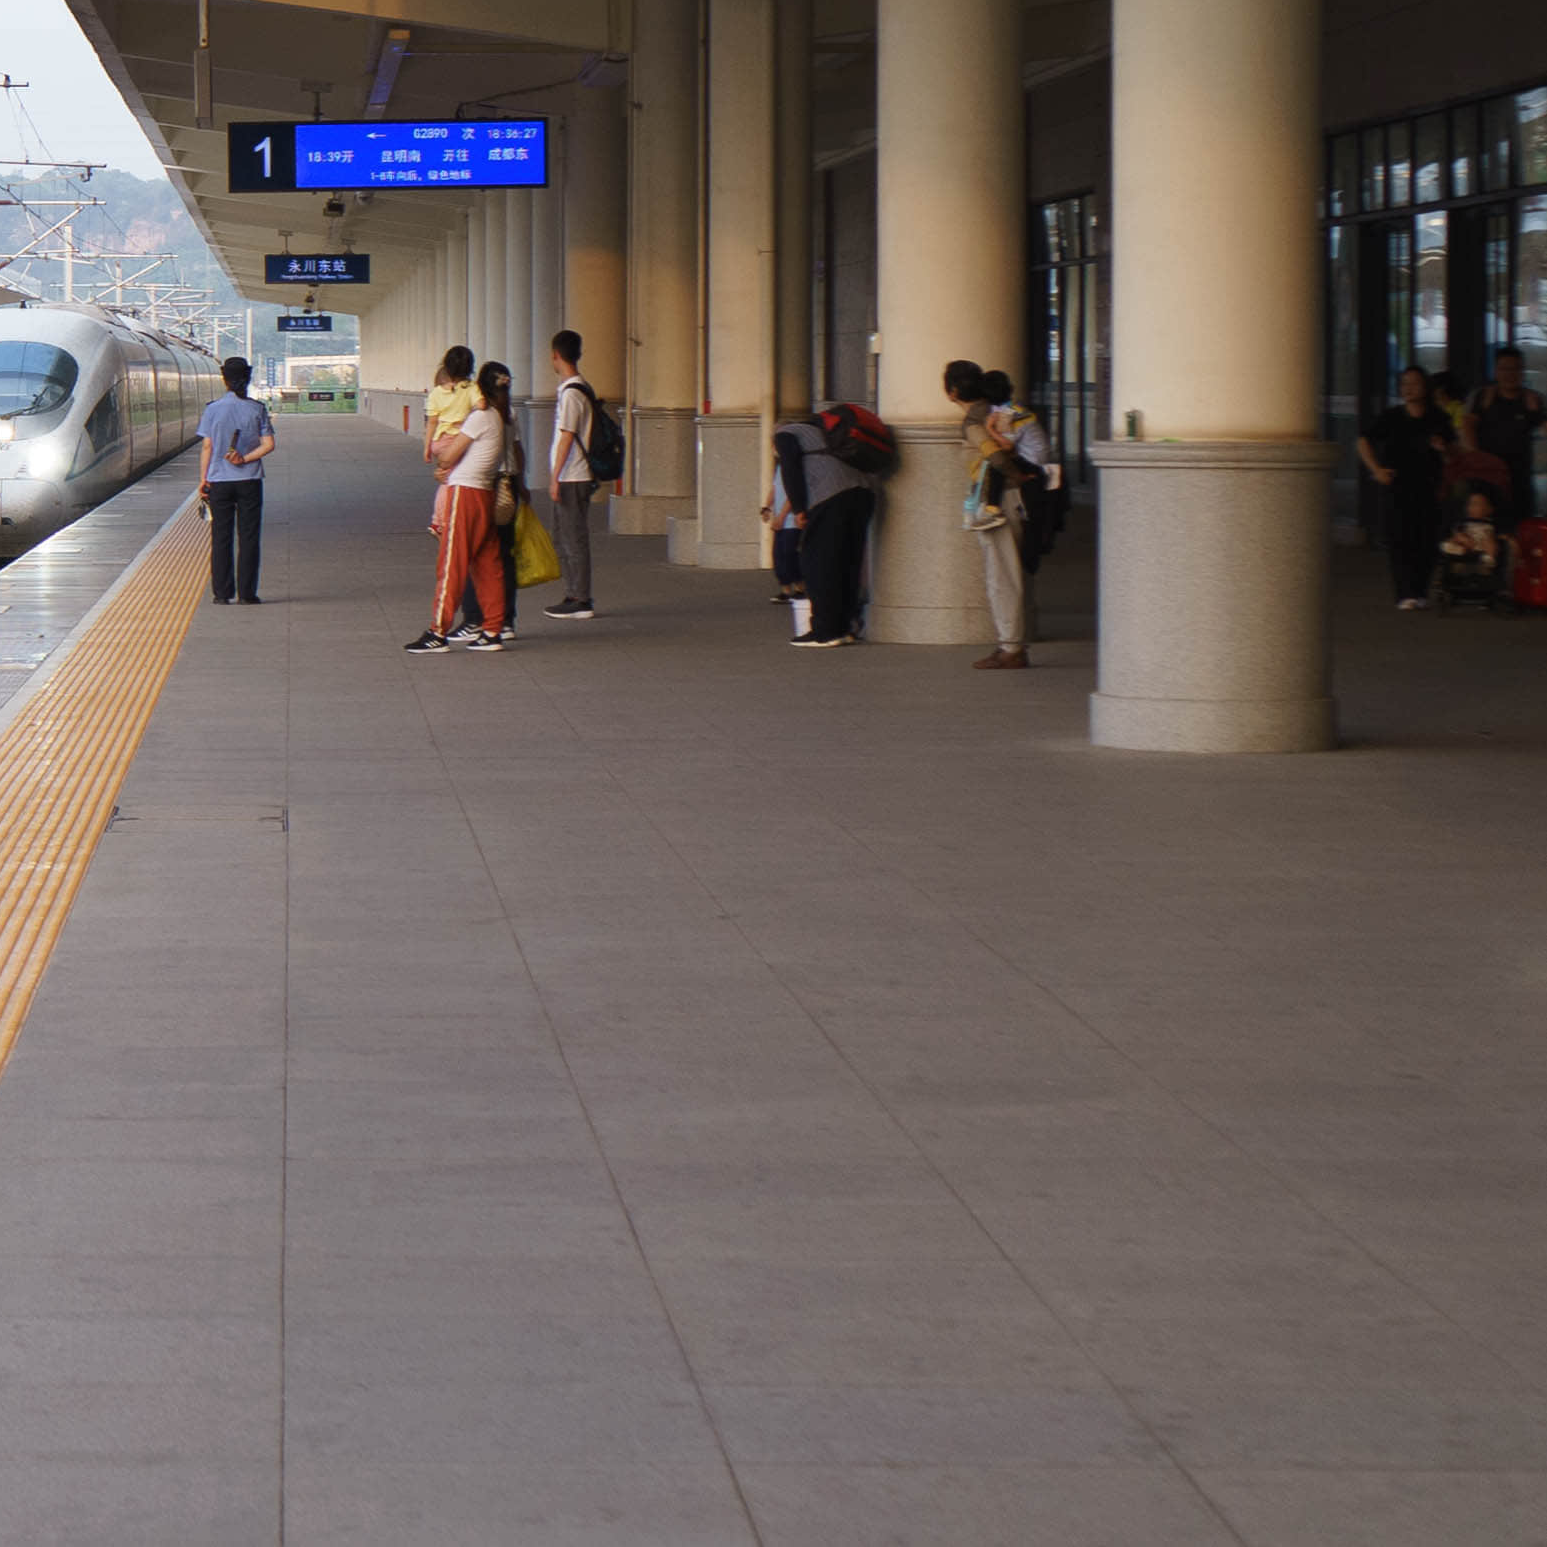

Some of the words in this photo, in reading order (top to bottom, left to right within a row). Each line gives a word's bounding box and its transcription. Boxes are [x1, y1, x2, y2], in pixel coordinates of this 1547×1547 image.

[462, 128, 475, 140] 次
[253, 136, 272, 178] 1
[288, 259, 347, 273] 永川东站
